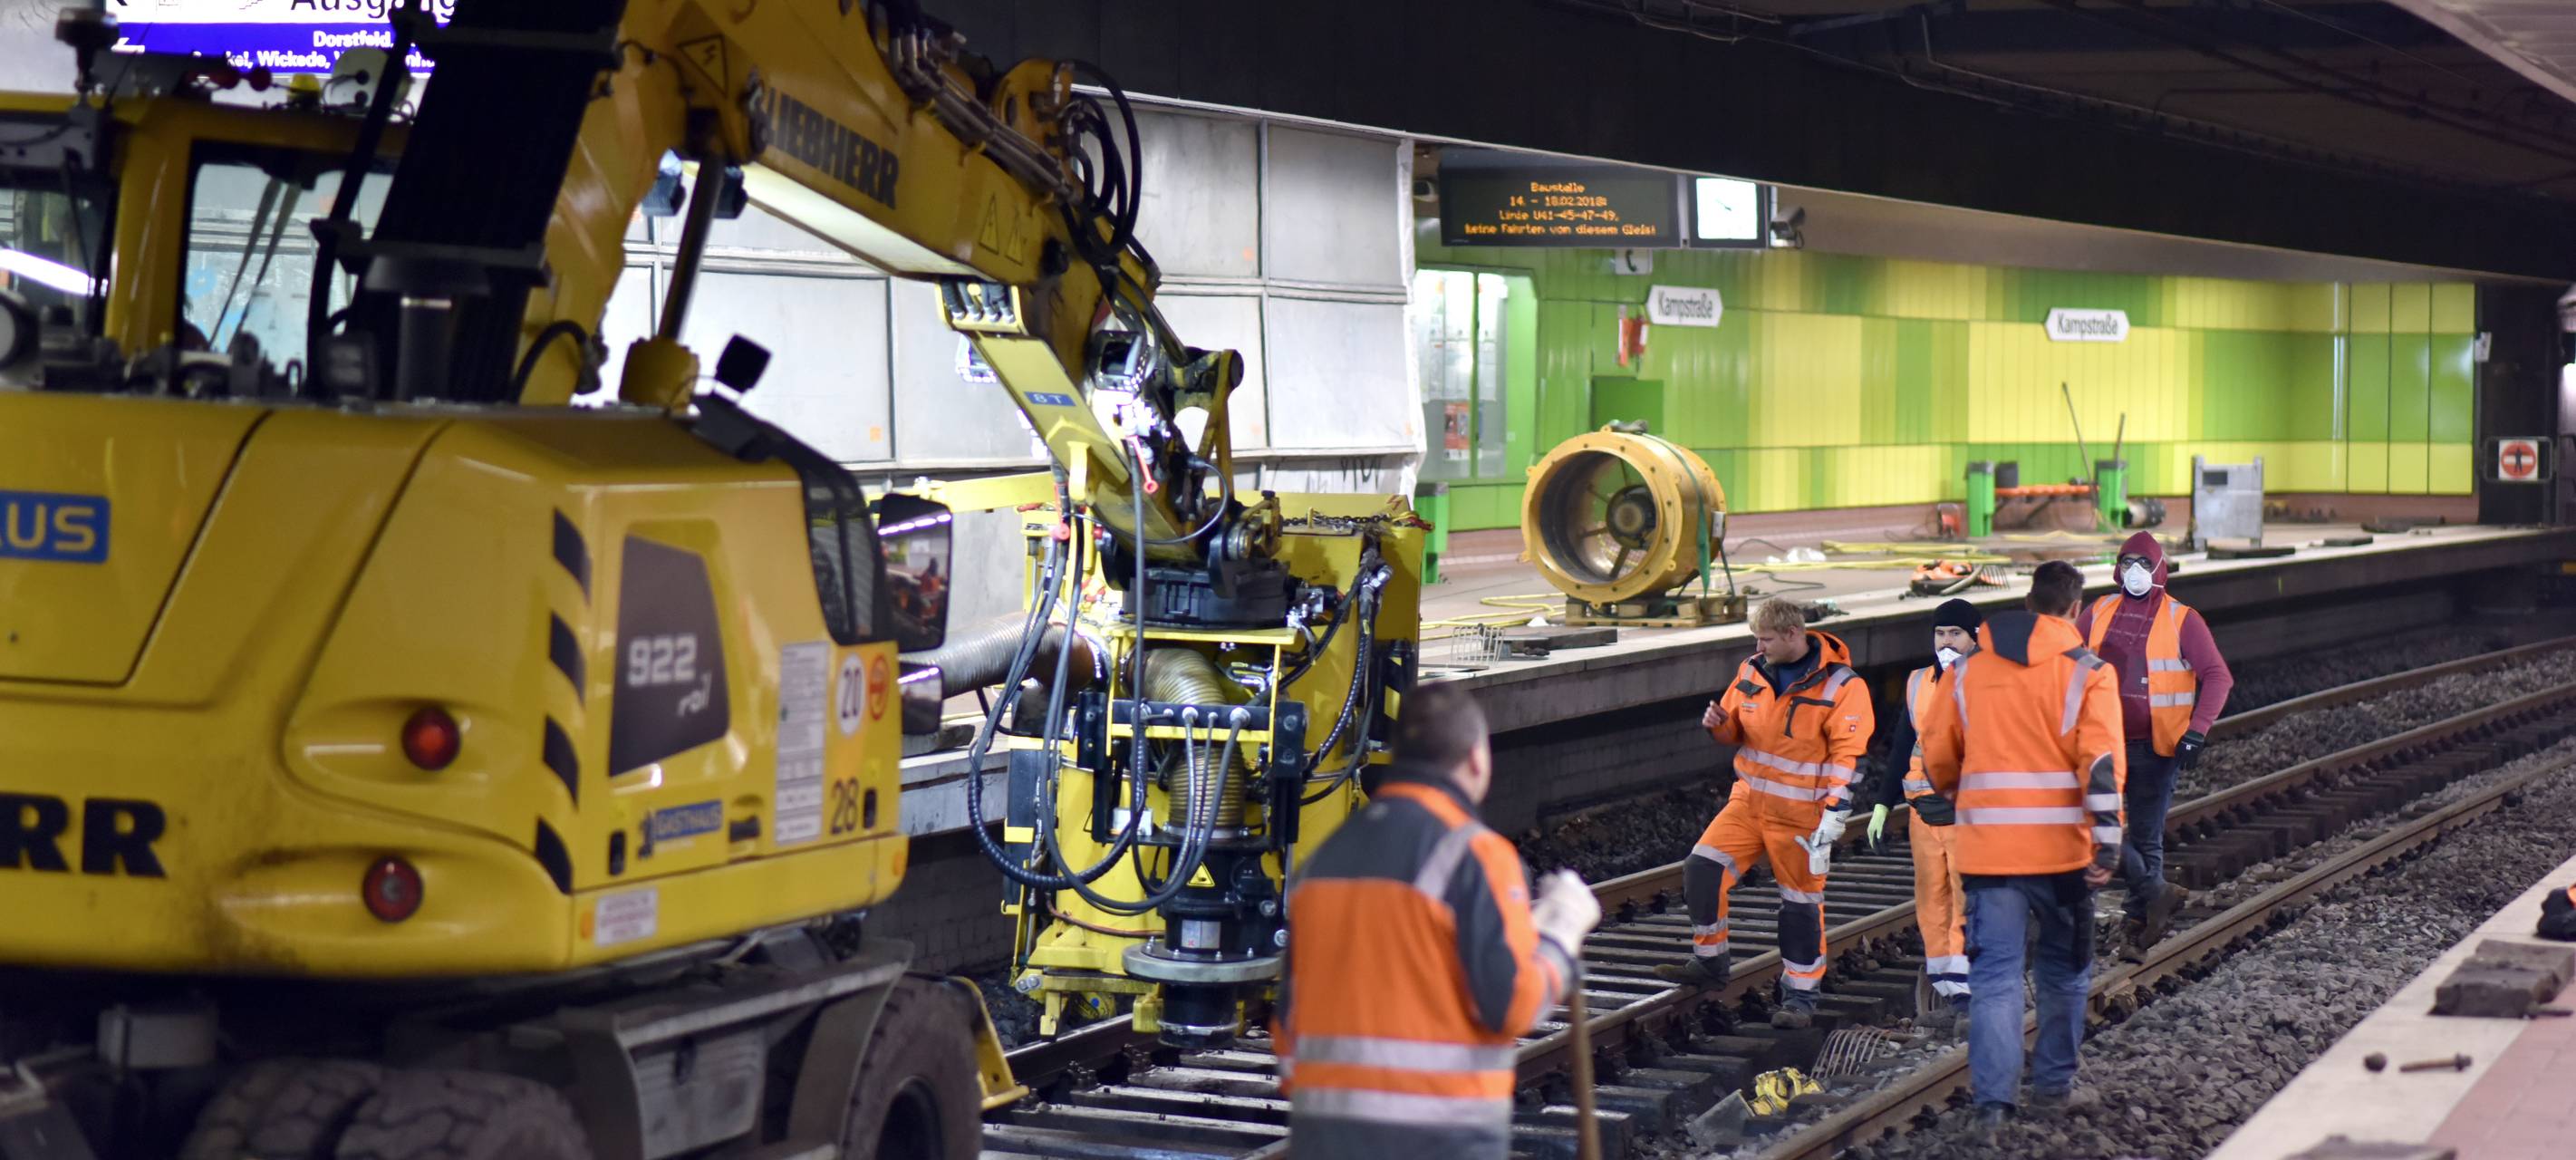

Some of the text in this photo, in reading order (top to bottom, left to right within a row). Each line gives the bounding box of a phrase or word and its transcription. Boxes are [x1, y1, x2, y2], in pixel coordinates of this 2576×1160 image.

[256, 51, 331, 69] Wickede,
[1530, 182, 1586, 193] Baustelle
[1464, 224, 1498, 235] keine
[1500, 224, 1546, 235] Fahrten
[1549, 227, 1572, 235] von
[1576, 224, 1619, 236] diesem
[1499, 210, 1529, 220] Linie
[1657, 290, 1713, 323] Kampstraße
[2057, 313, 2118, 341] Kampstraße
[0, 503, 95, 552] US
[627, 634, 698, 687] 922
[841, 666, 862, 720] 20
[830, 777, 860, 836] 28
